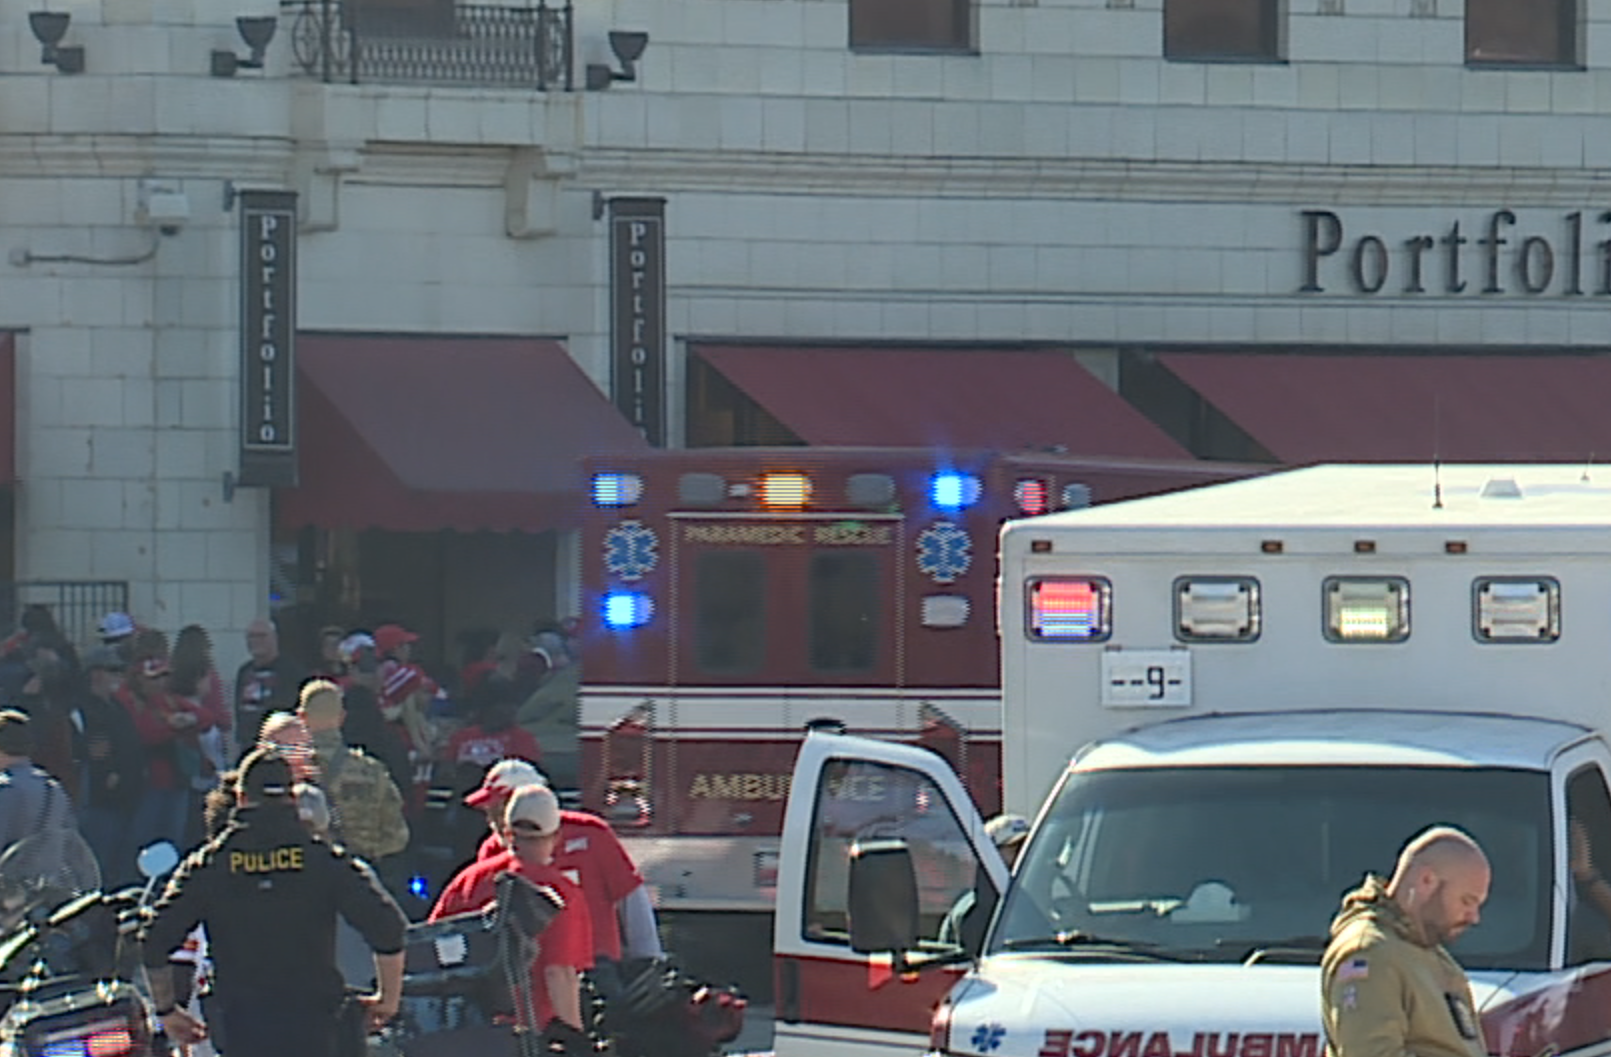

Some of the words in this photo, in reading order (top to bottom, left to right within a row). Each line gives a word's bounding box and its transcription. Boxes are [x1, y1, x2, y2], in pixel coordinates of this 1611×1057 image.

[260, 215, 276, 442] Portfolio
[629, 222, 646, 440] Portfoli
[684, 525, 806, 544] PARAMEDIC
[814, 525, 893, 545] RESCUE
[230, 847, 304, 873] POLICE
